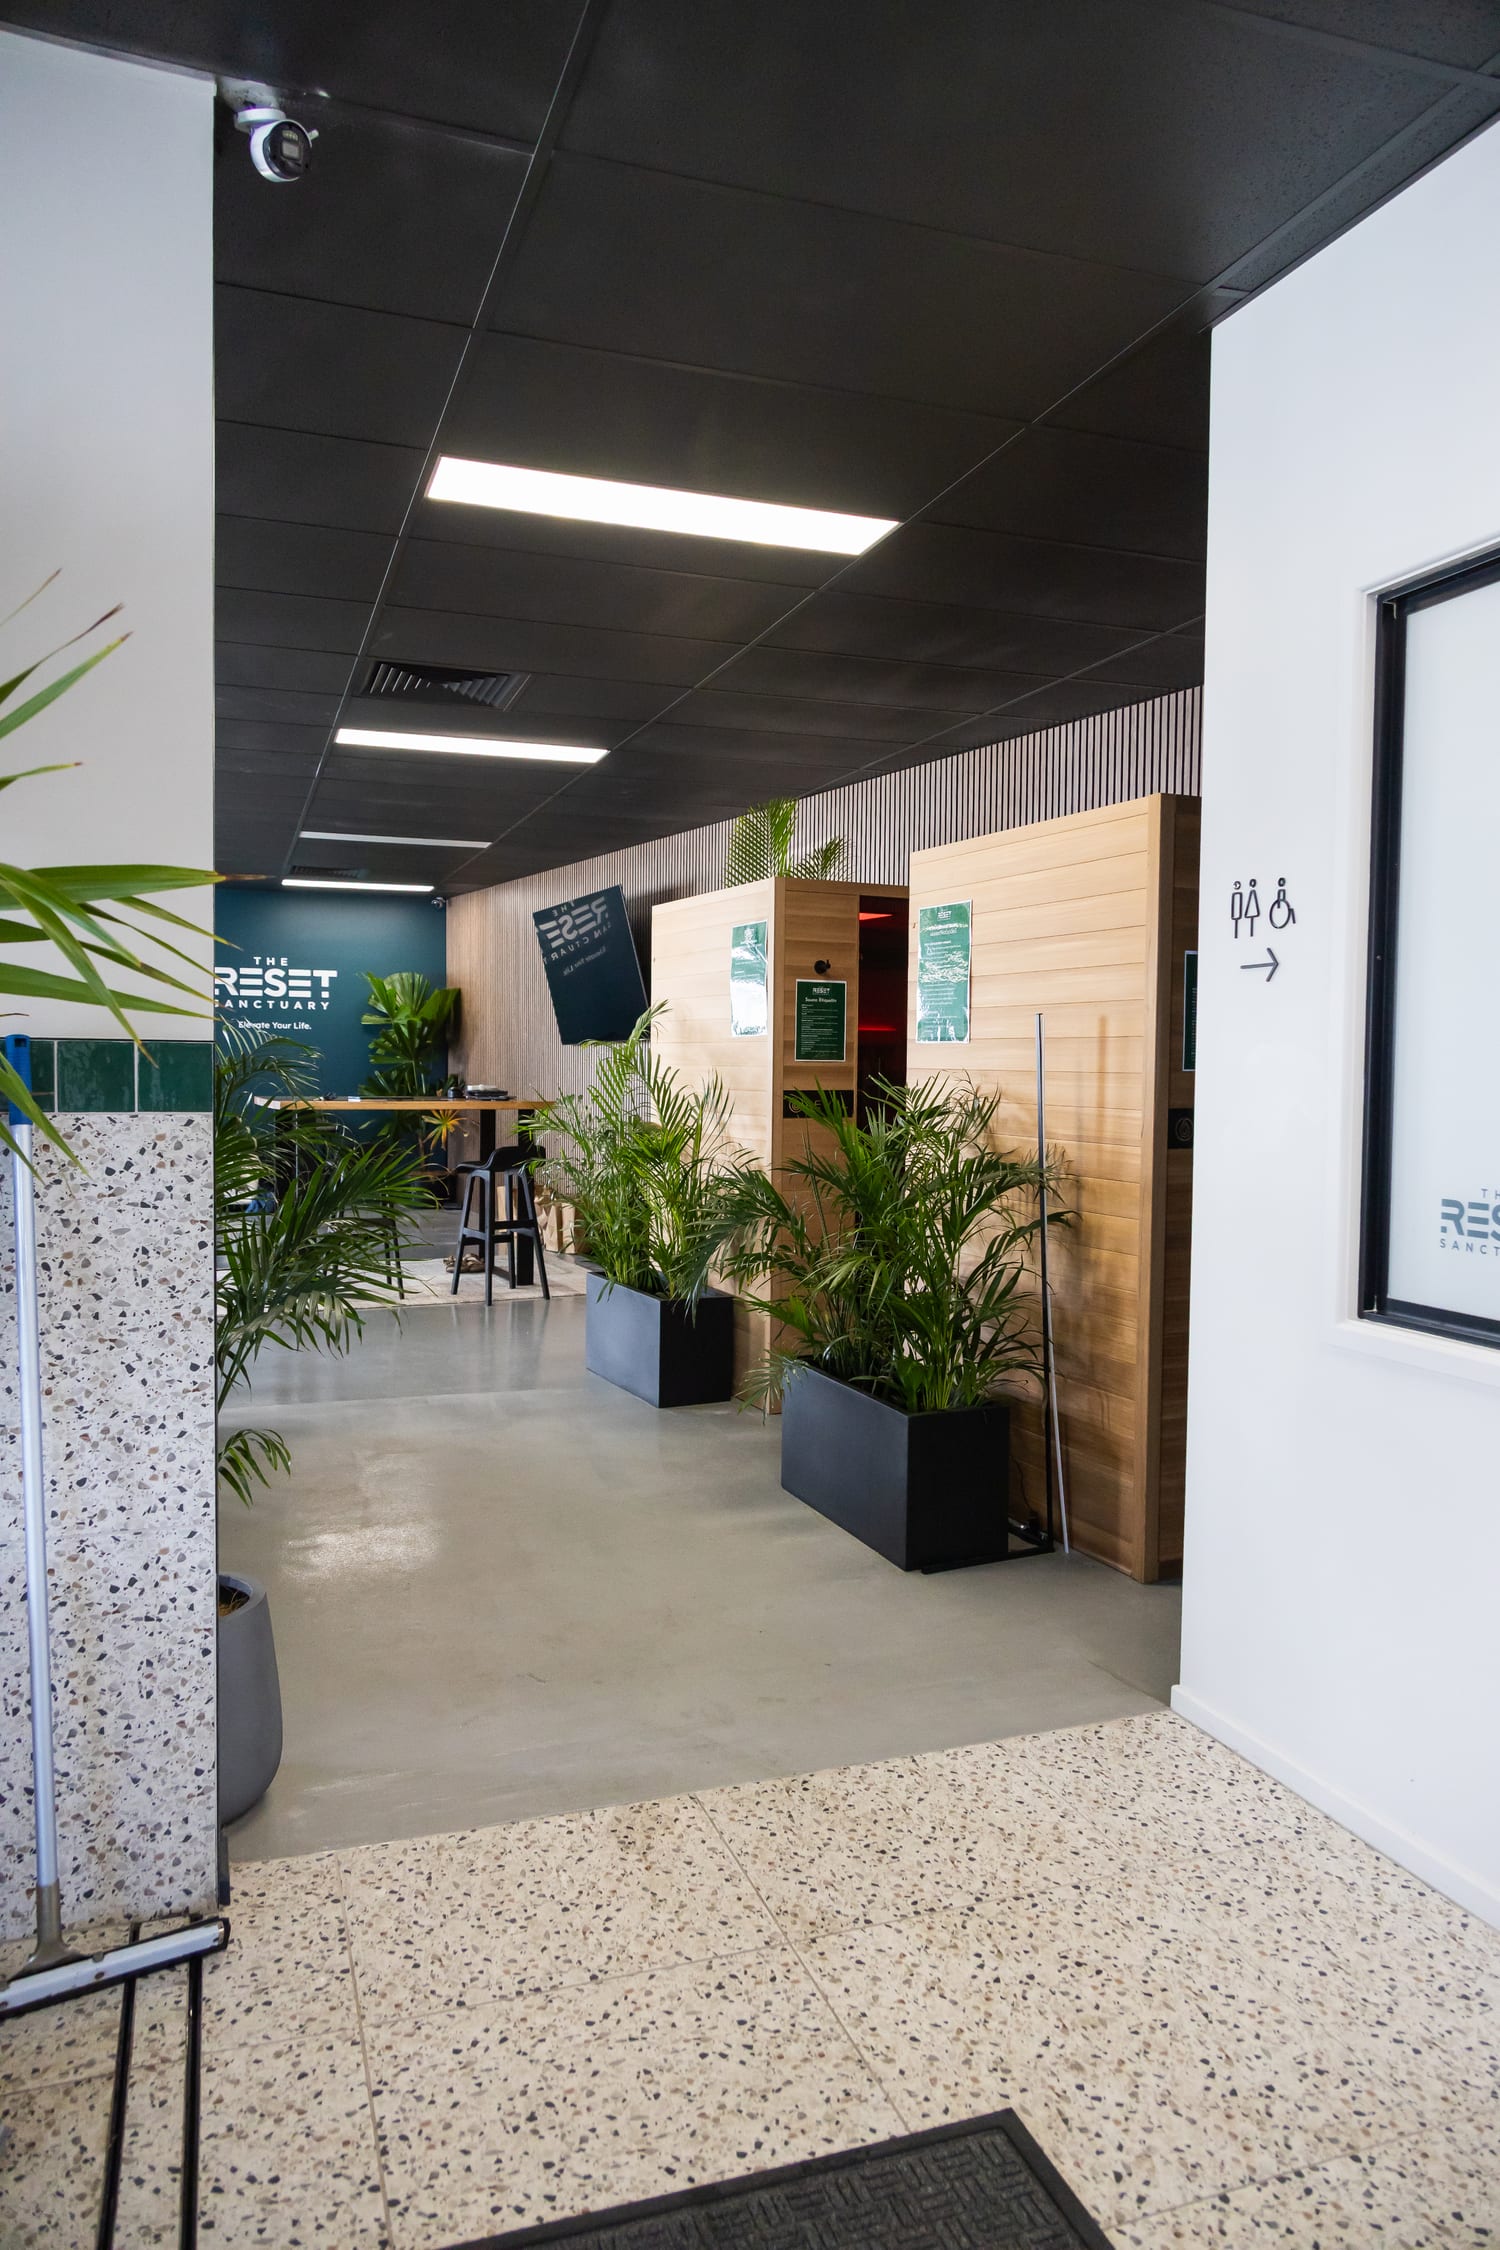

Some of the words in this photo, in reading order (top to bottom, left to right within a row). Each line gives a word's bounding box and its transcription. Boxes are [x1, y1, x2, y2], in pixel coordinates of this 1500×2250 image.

[253, 956, 289, 967] THE
[214, 966, 338, 999] RESET
[272, 1022, 291, 1030] Your
[293, 1022, 312, 1031] Life.
